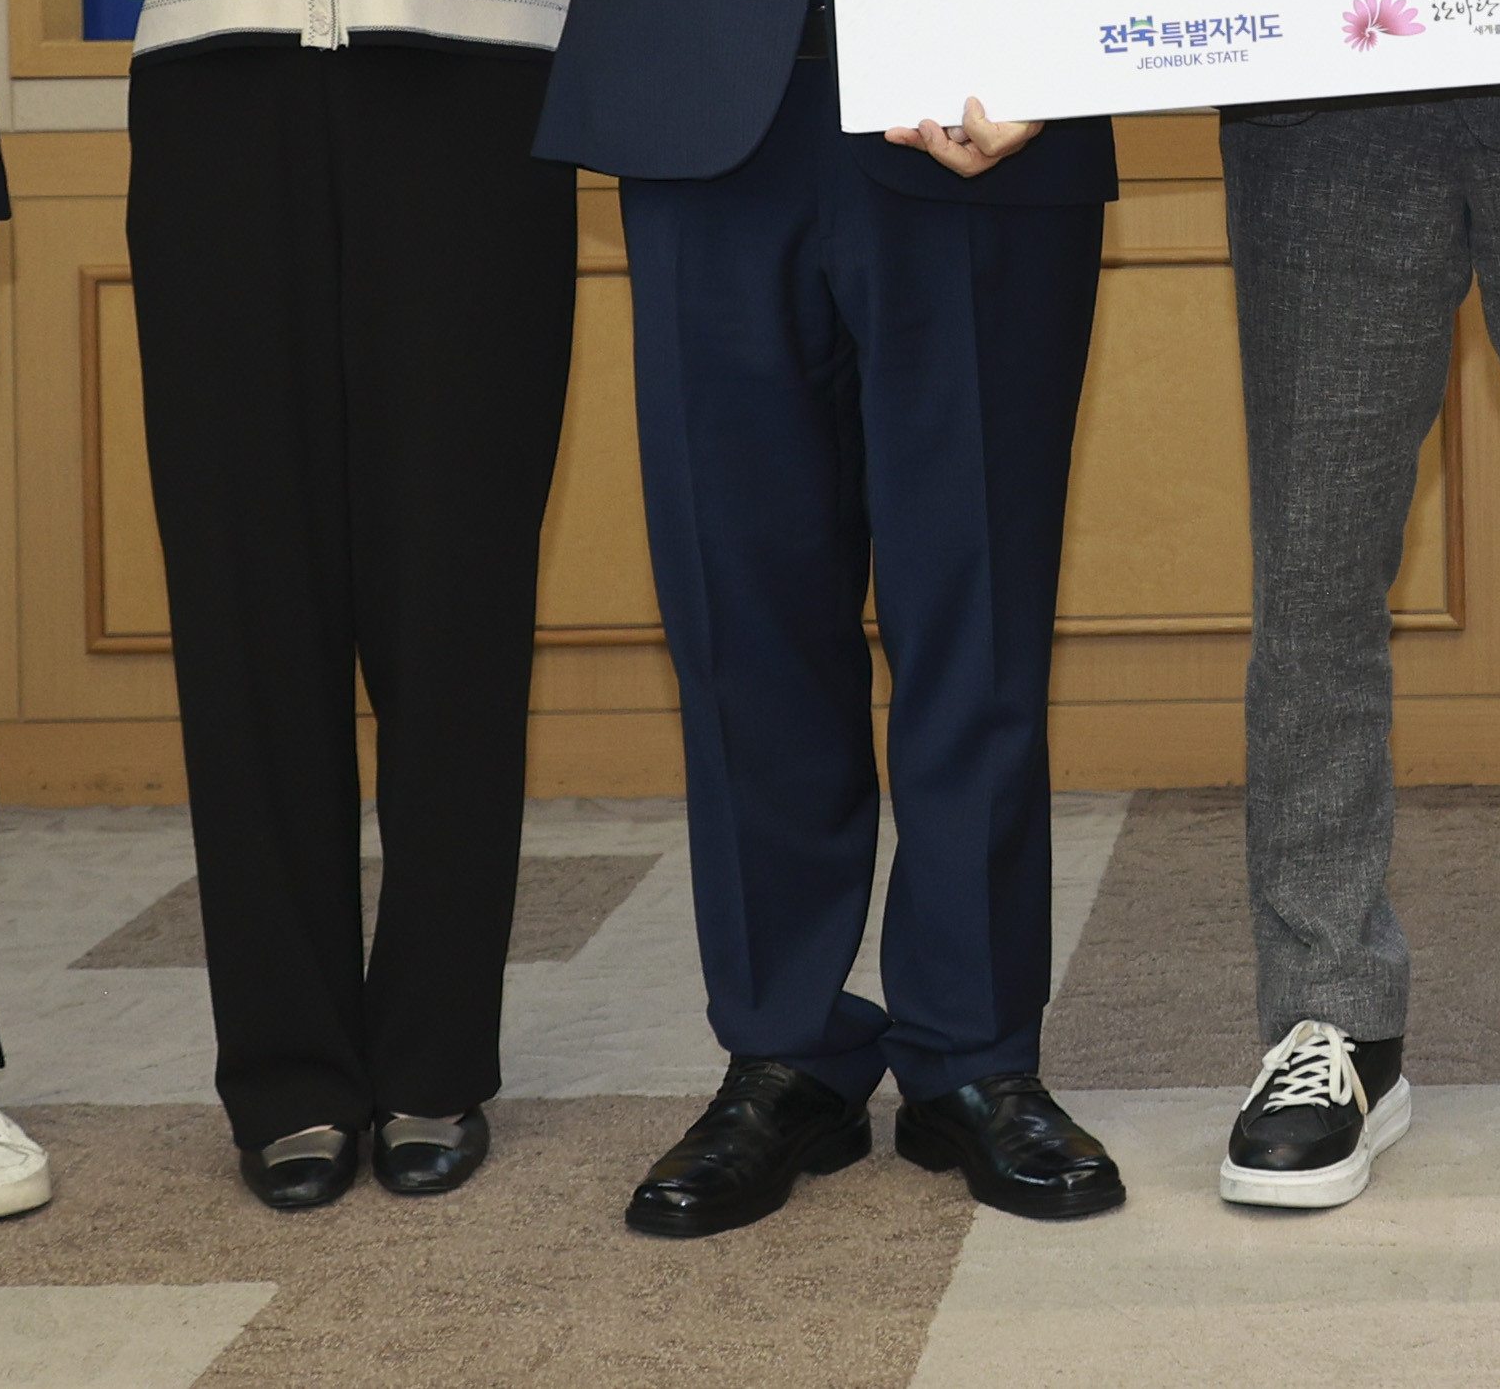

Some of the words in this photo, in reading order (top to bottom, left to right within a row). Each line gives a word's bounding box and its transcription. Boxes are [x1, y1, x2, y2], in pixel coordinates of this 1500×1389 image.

[1099, 13, 1283, 54] 전북특별자치도
[1136, 53, 1203, 70] JEONBUK
[1206, 49, 1249, 65] STATE
